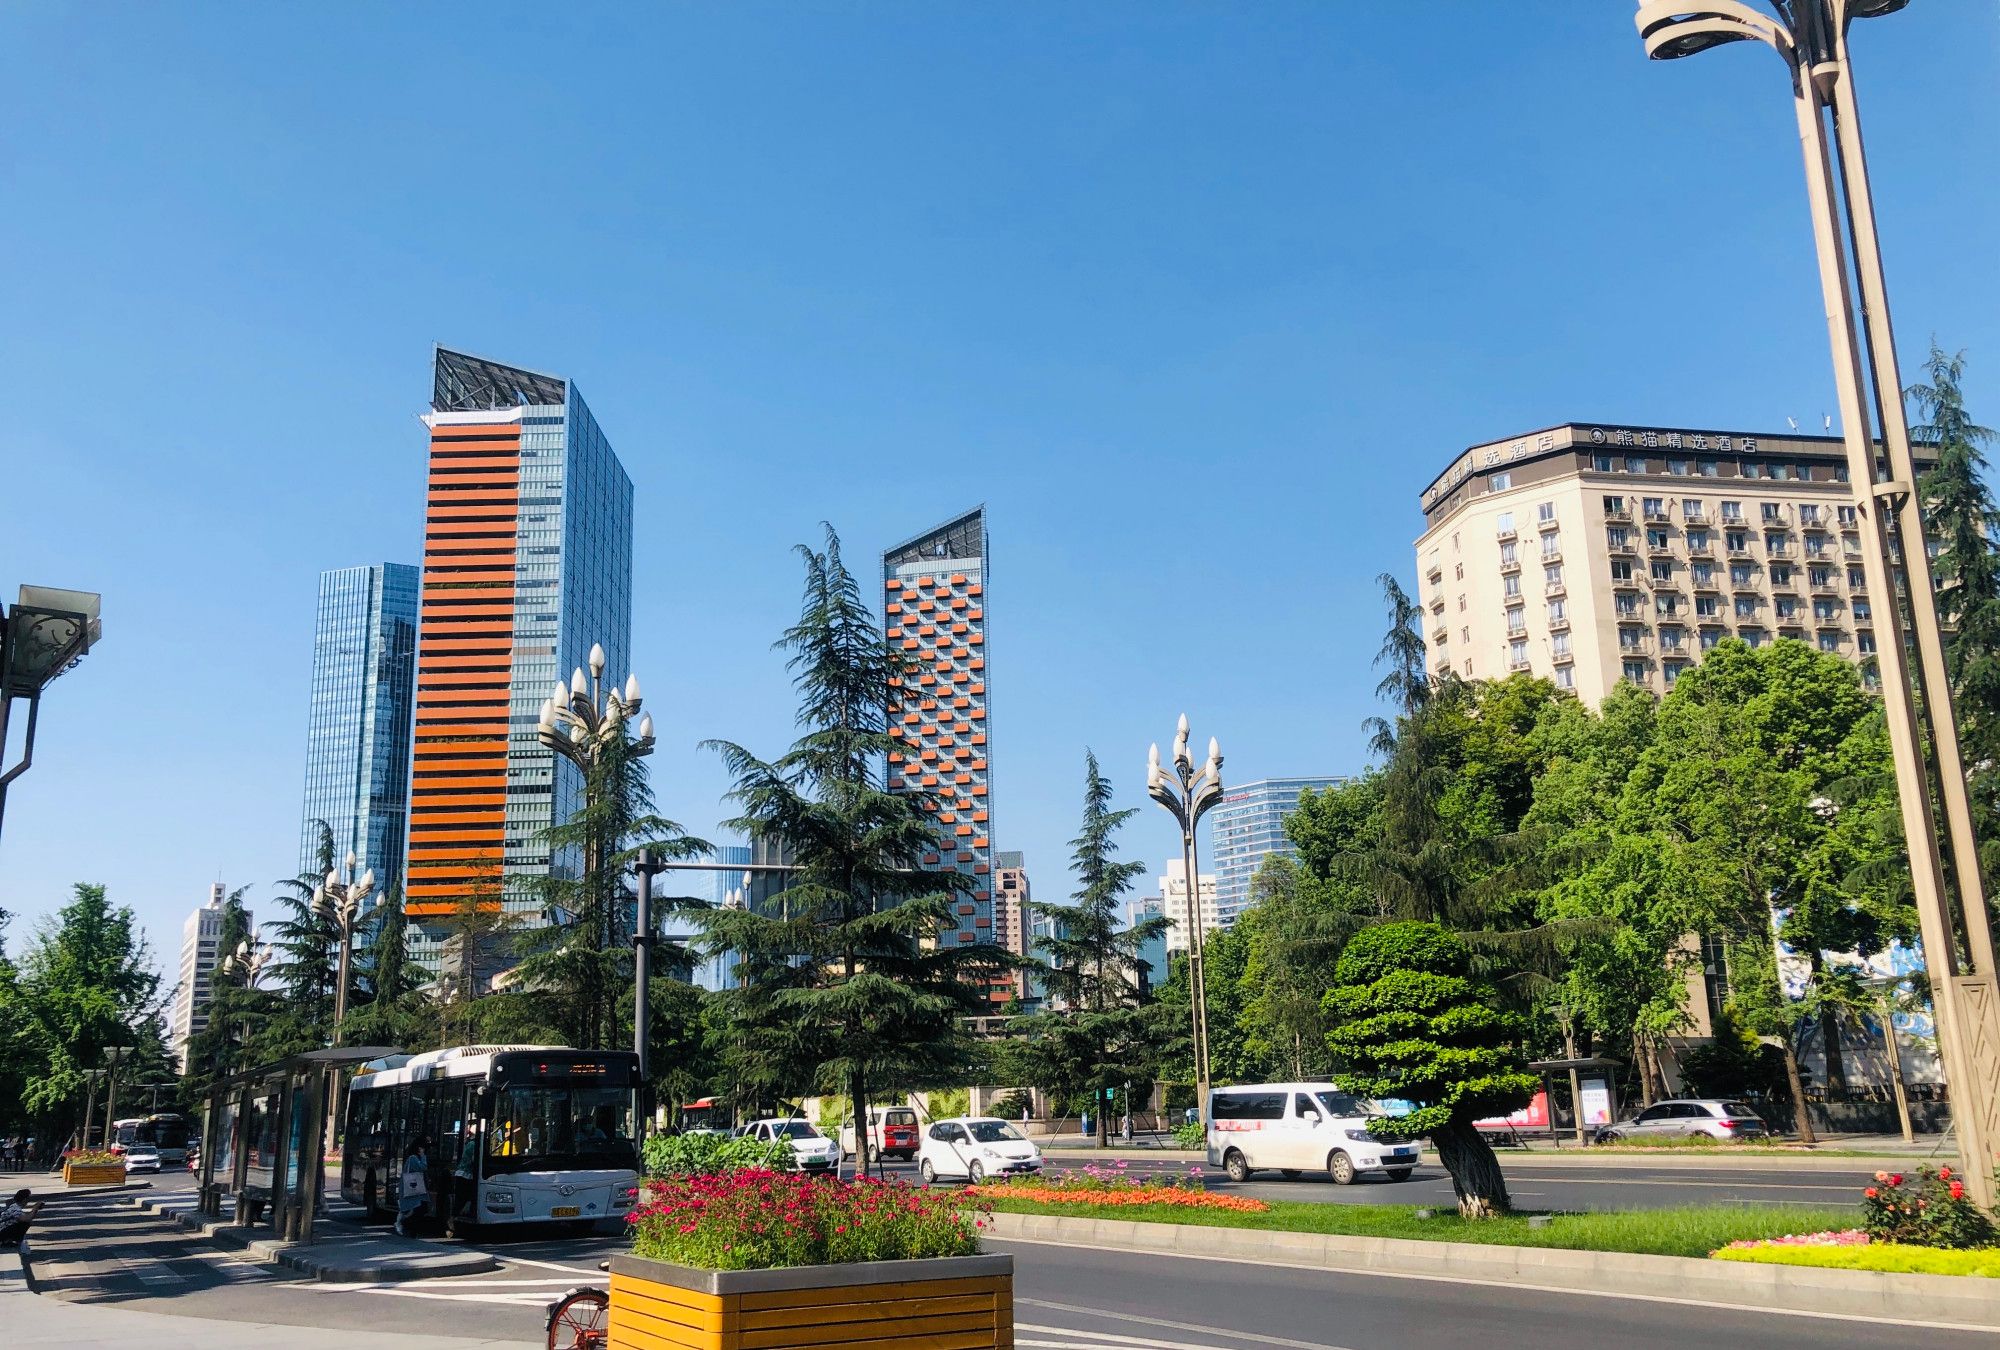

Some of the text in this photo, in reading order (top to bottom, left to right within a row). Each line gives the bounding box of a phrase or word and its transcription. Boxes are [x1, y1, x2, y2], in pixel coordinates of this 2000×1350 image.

[1615, 429, 1757, 453] 熊猫精选酒店
